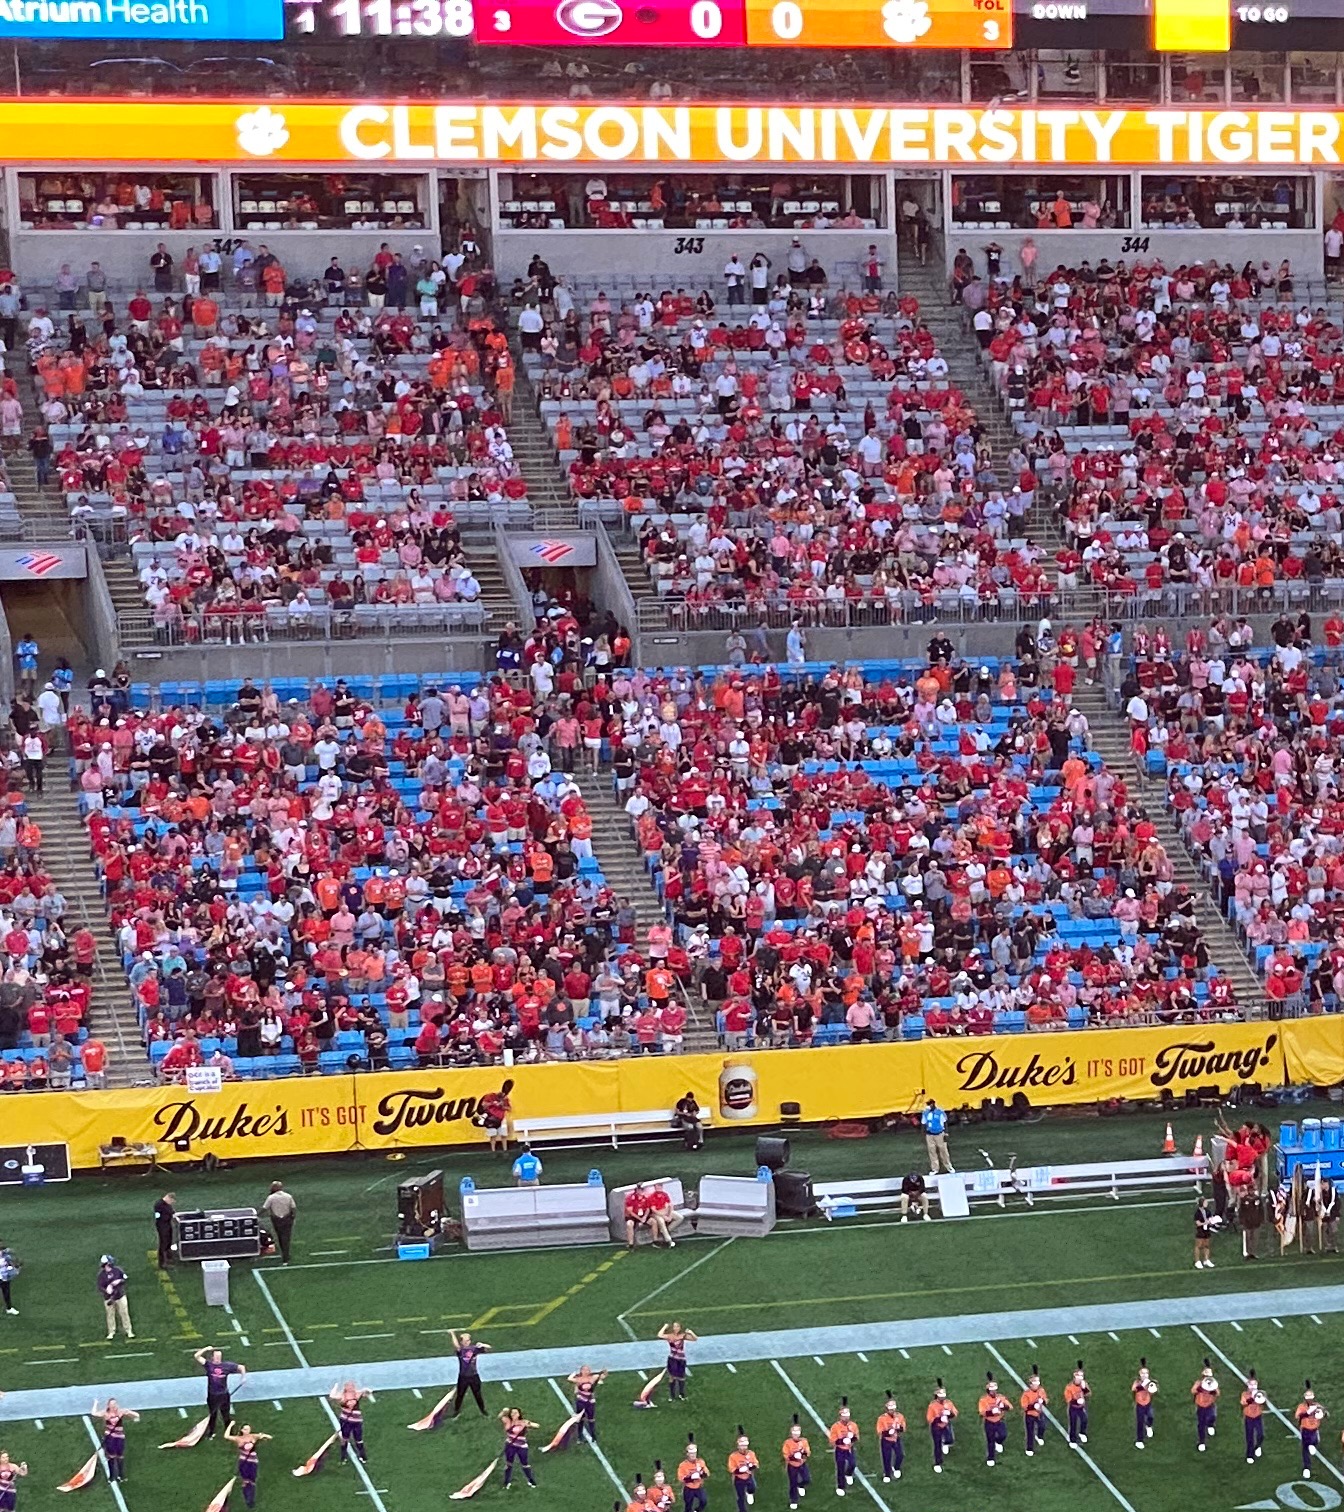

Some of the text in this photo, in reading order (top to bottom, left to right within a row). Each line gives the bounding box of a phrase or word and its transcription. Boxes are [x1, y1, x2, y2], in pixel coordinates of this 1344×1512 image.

[107, 0, 209, 23] Health
[334, 0, 474, 35] 11:38
[493, 11, 511, 31] 3
[690, 1, 722, 38] 0
[772, 1, 802, 38] 0
[1033, 3, 1087, 19] DOWN
[1237, 6, 1288, 23] TO GO
[984, 21, 999, 40] 3
[340, 106, 690, 160] CLEMSON
[716, 107, 1128, 162] UNIVERSITY
[1145, 110, 1341, 164] TIGER
[674, 237, 705, 254] 343
[1121, 237, 1150, 253] 344
[956, 1034, 1277, 1092] Duke's IT'S GOT Twang!
[154, 1098, 293, 1143] Duke's
[301, 1107, 330, 1128] IT'S
[337, 1104, 367, 1125] GOT
